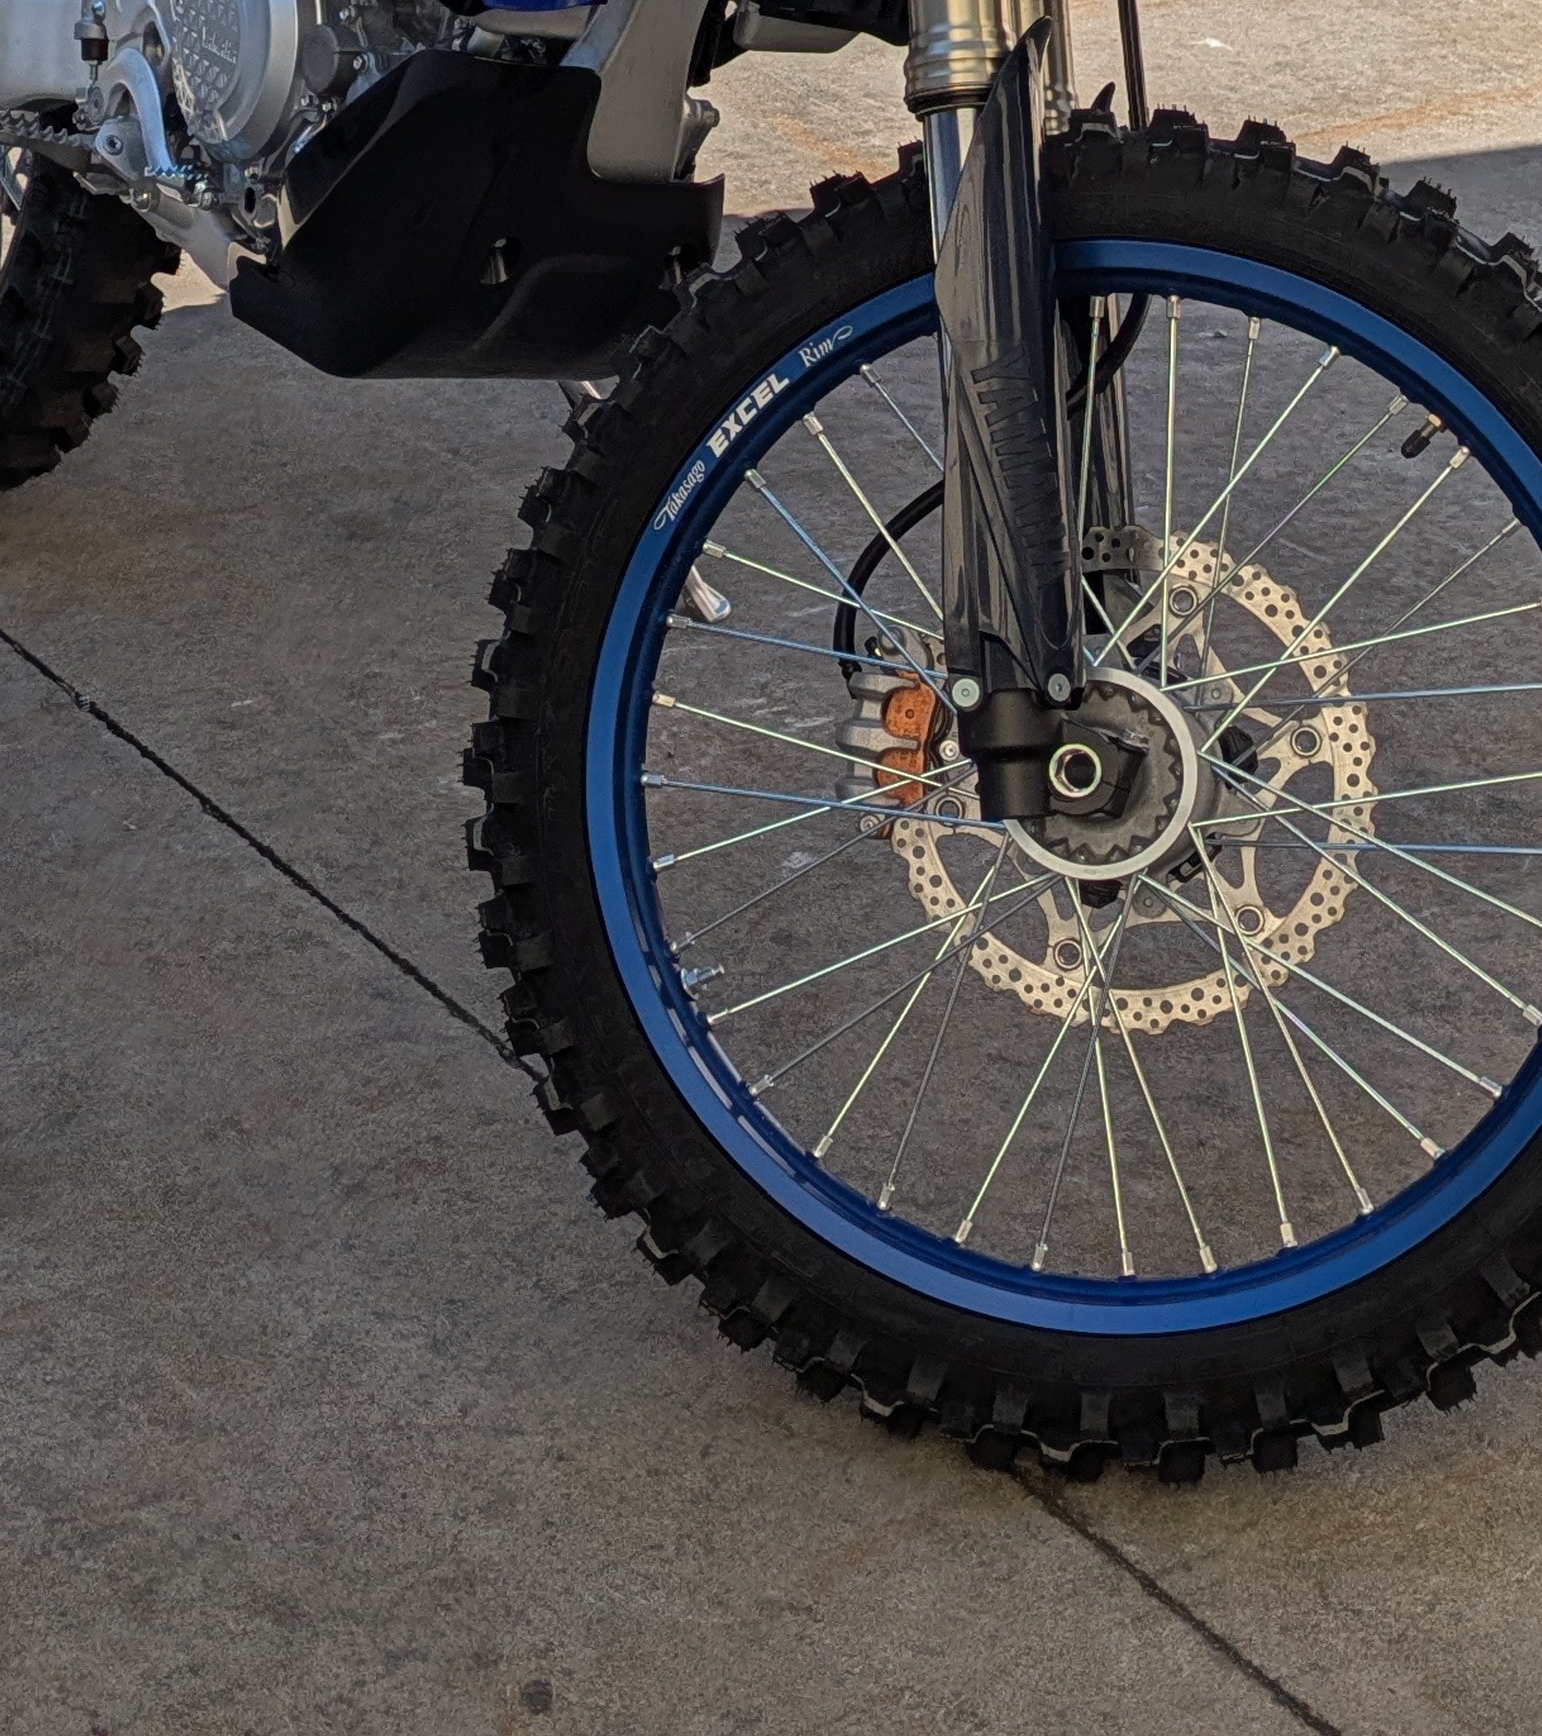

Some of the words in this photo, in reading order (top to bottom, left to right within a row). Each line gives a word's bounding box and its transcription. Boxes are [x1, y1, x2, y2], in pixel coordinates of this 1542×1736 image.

[653, 459, 706, 531] Takasago
[706, 373, 790, 459] EXCEL
[798, 325, 853, 368] Rim
[970, 346, 1071, 589] YAMAHA
